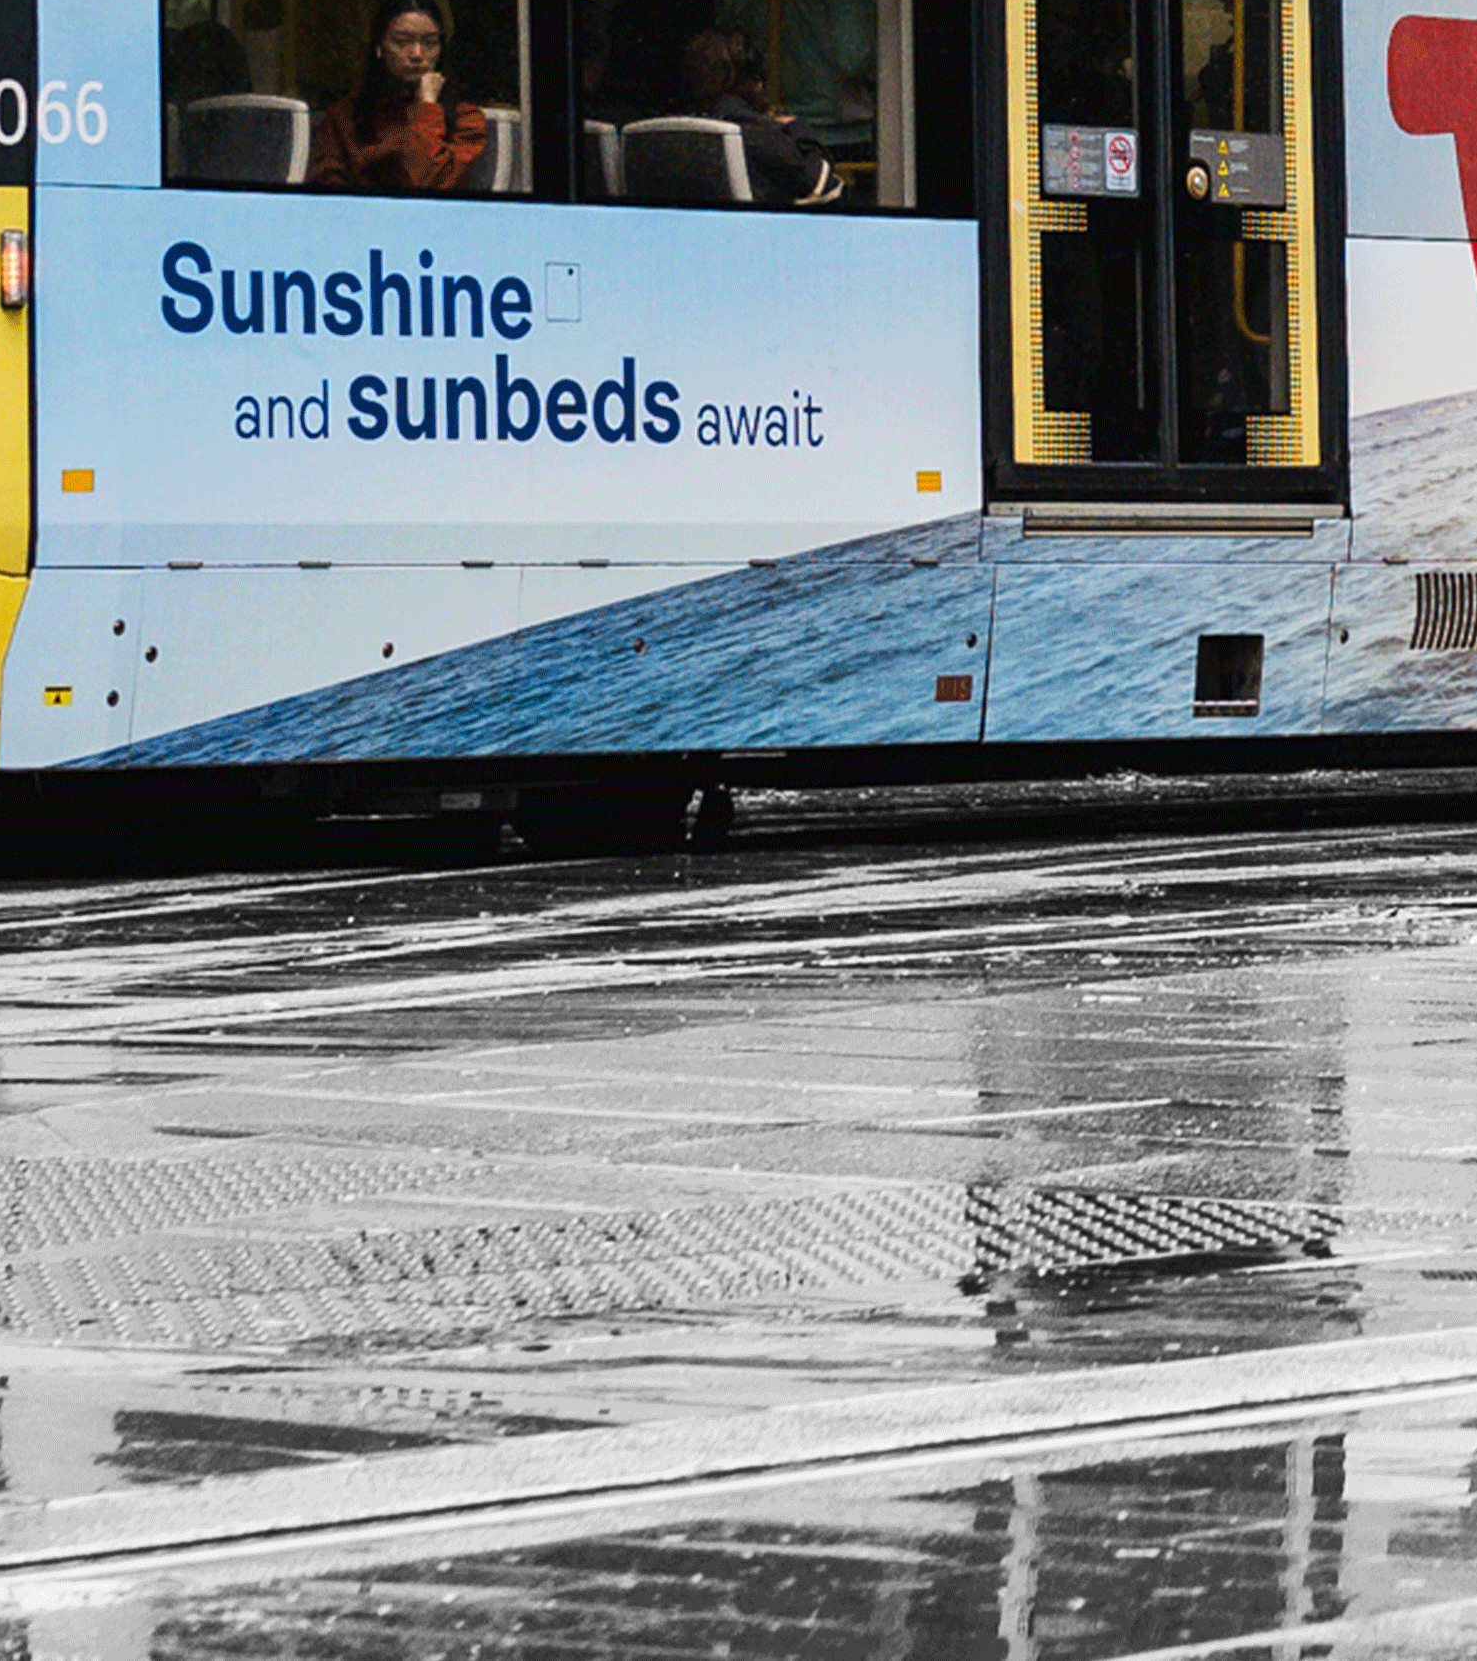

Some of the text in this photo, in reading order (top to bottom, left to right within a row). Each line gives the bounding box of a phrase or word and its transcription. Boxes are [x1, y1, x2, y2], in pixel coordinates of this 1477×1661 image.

[160, 240, 533, 340] Sunshine
[234, 354, 825, 448] and sunbeds await
